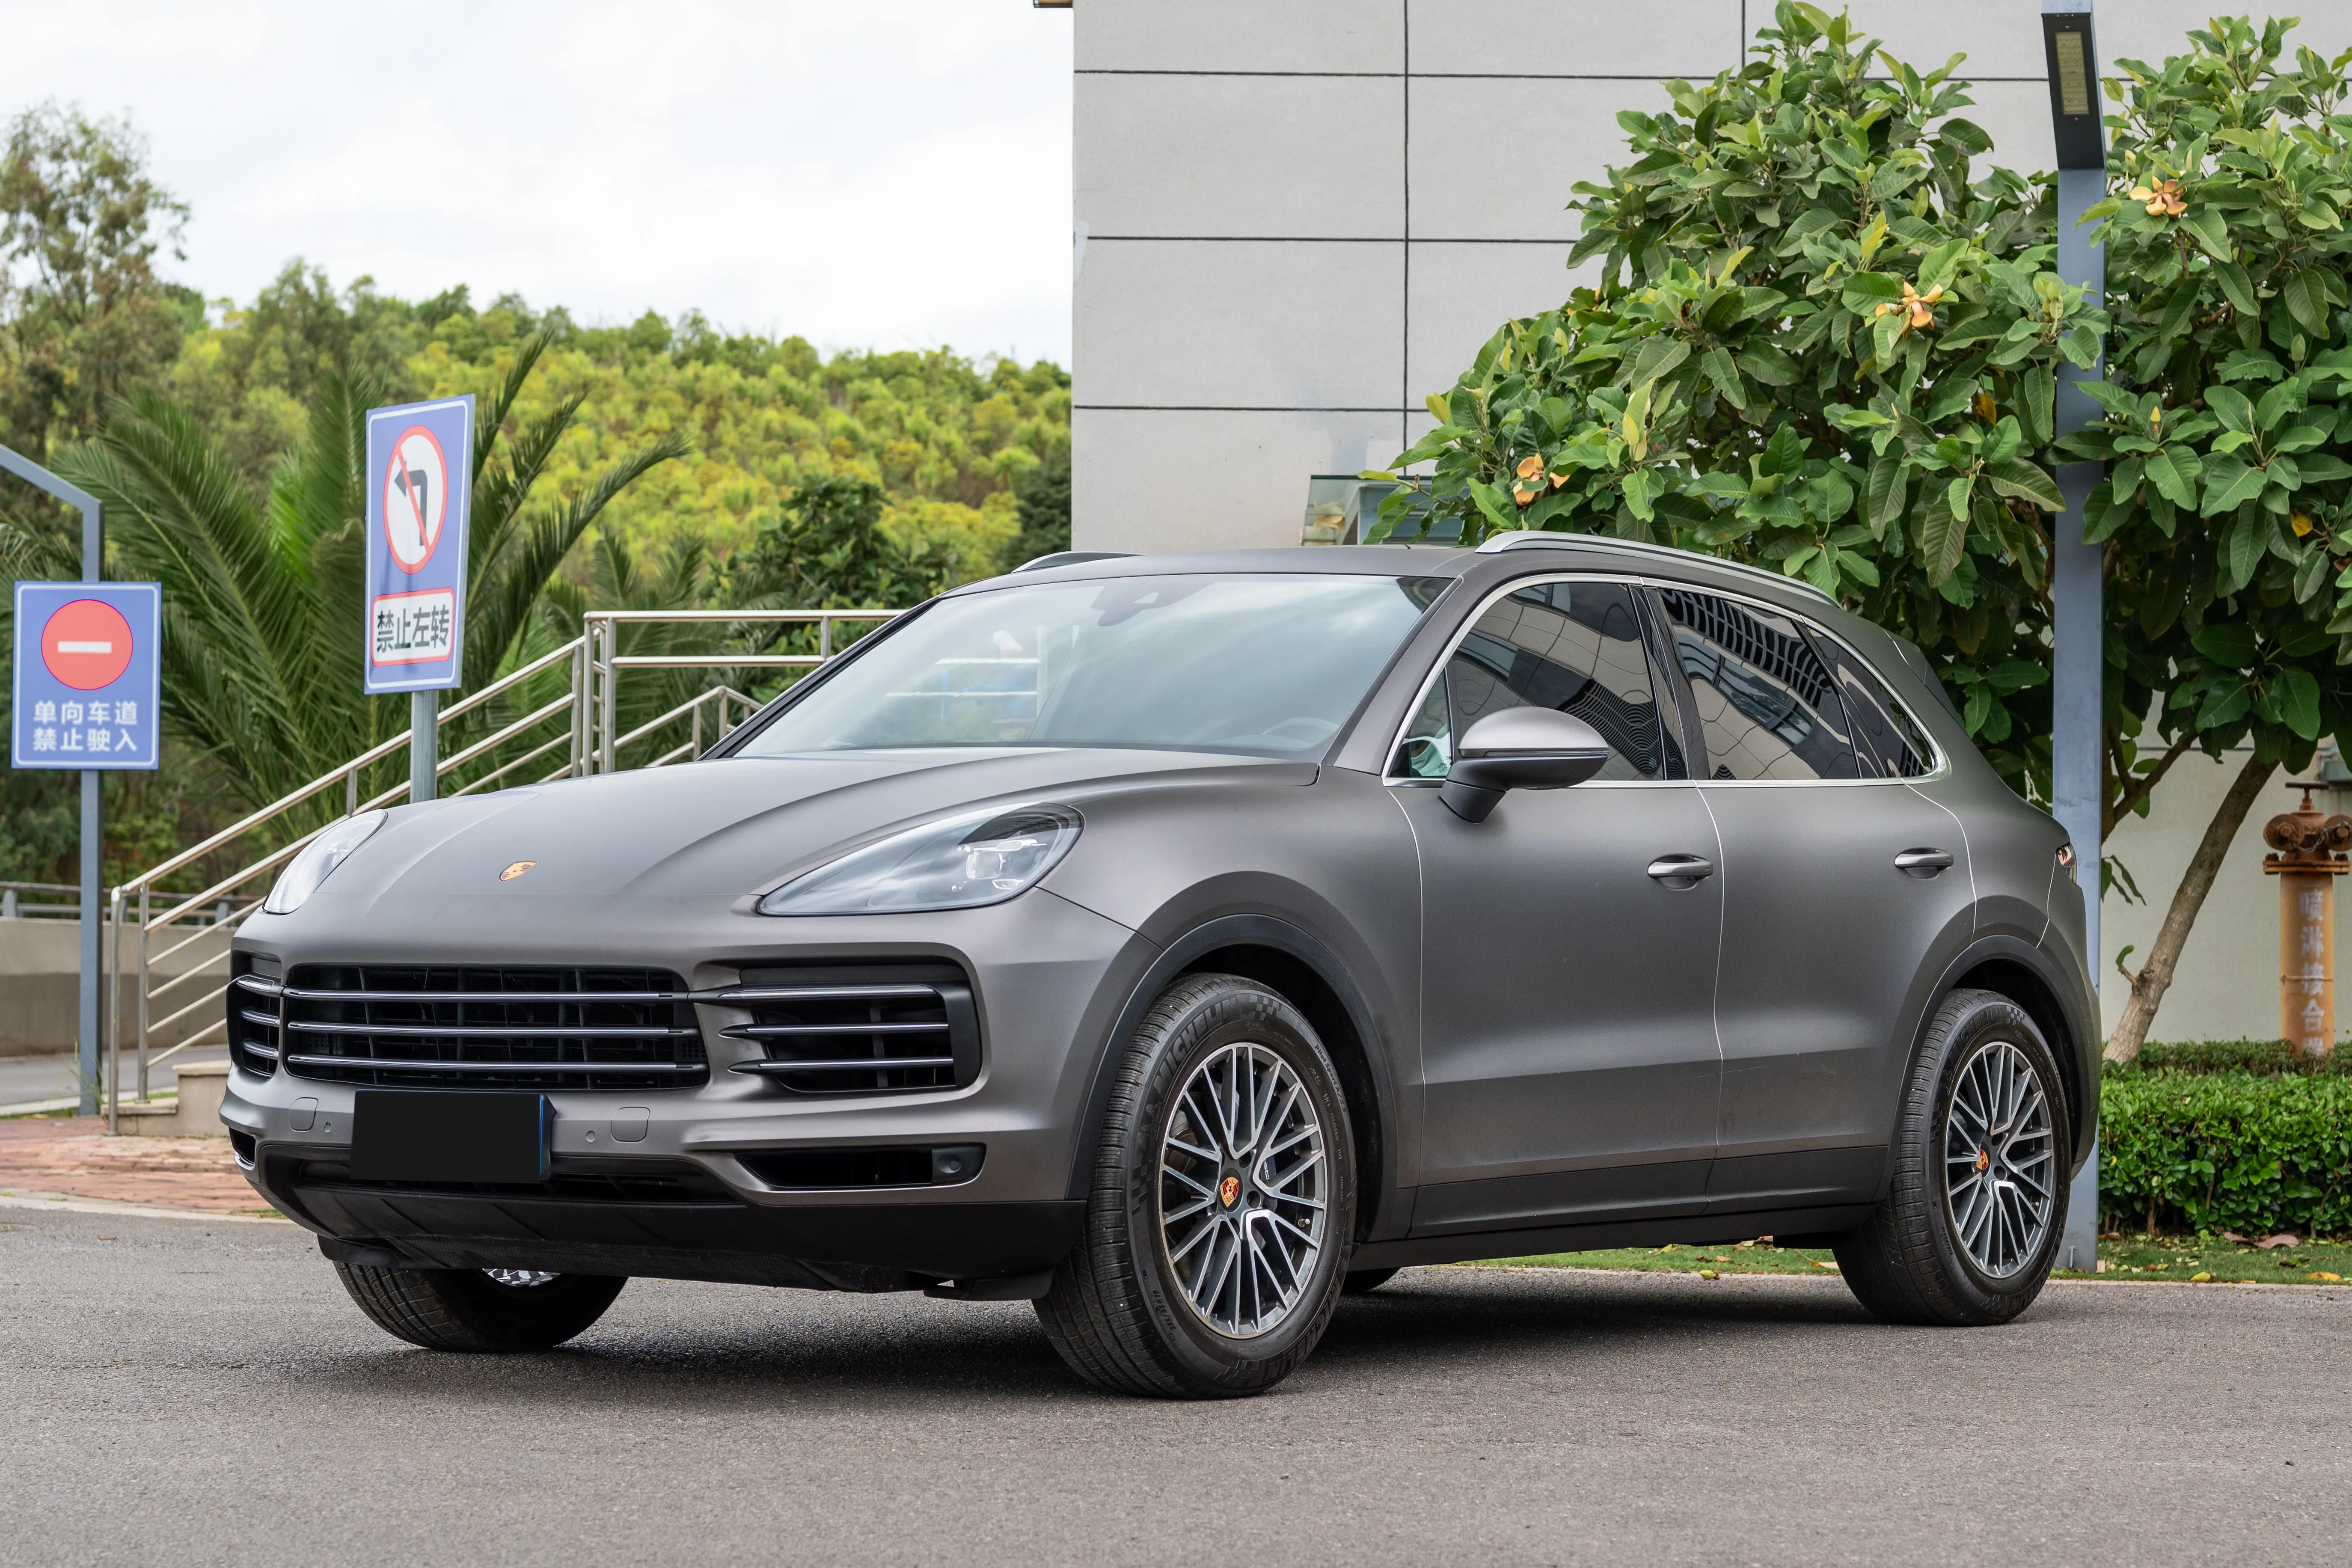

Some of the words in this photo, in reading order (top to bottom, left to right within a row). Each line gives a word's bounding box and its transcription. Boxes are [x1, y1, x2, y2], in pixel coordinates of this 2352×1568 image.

[377, 604, 450, 653] 禁止左转
[33, 700, 138, 725] 单向车道
[33, 728, 137, 752] 禁止驶入
[1153, 994, 1240, 1099] MICHELIN
[1315, 1045, 1326, 1064] Pilot
[1325, 1063, 1337, 1085] Sport
